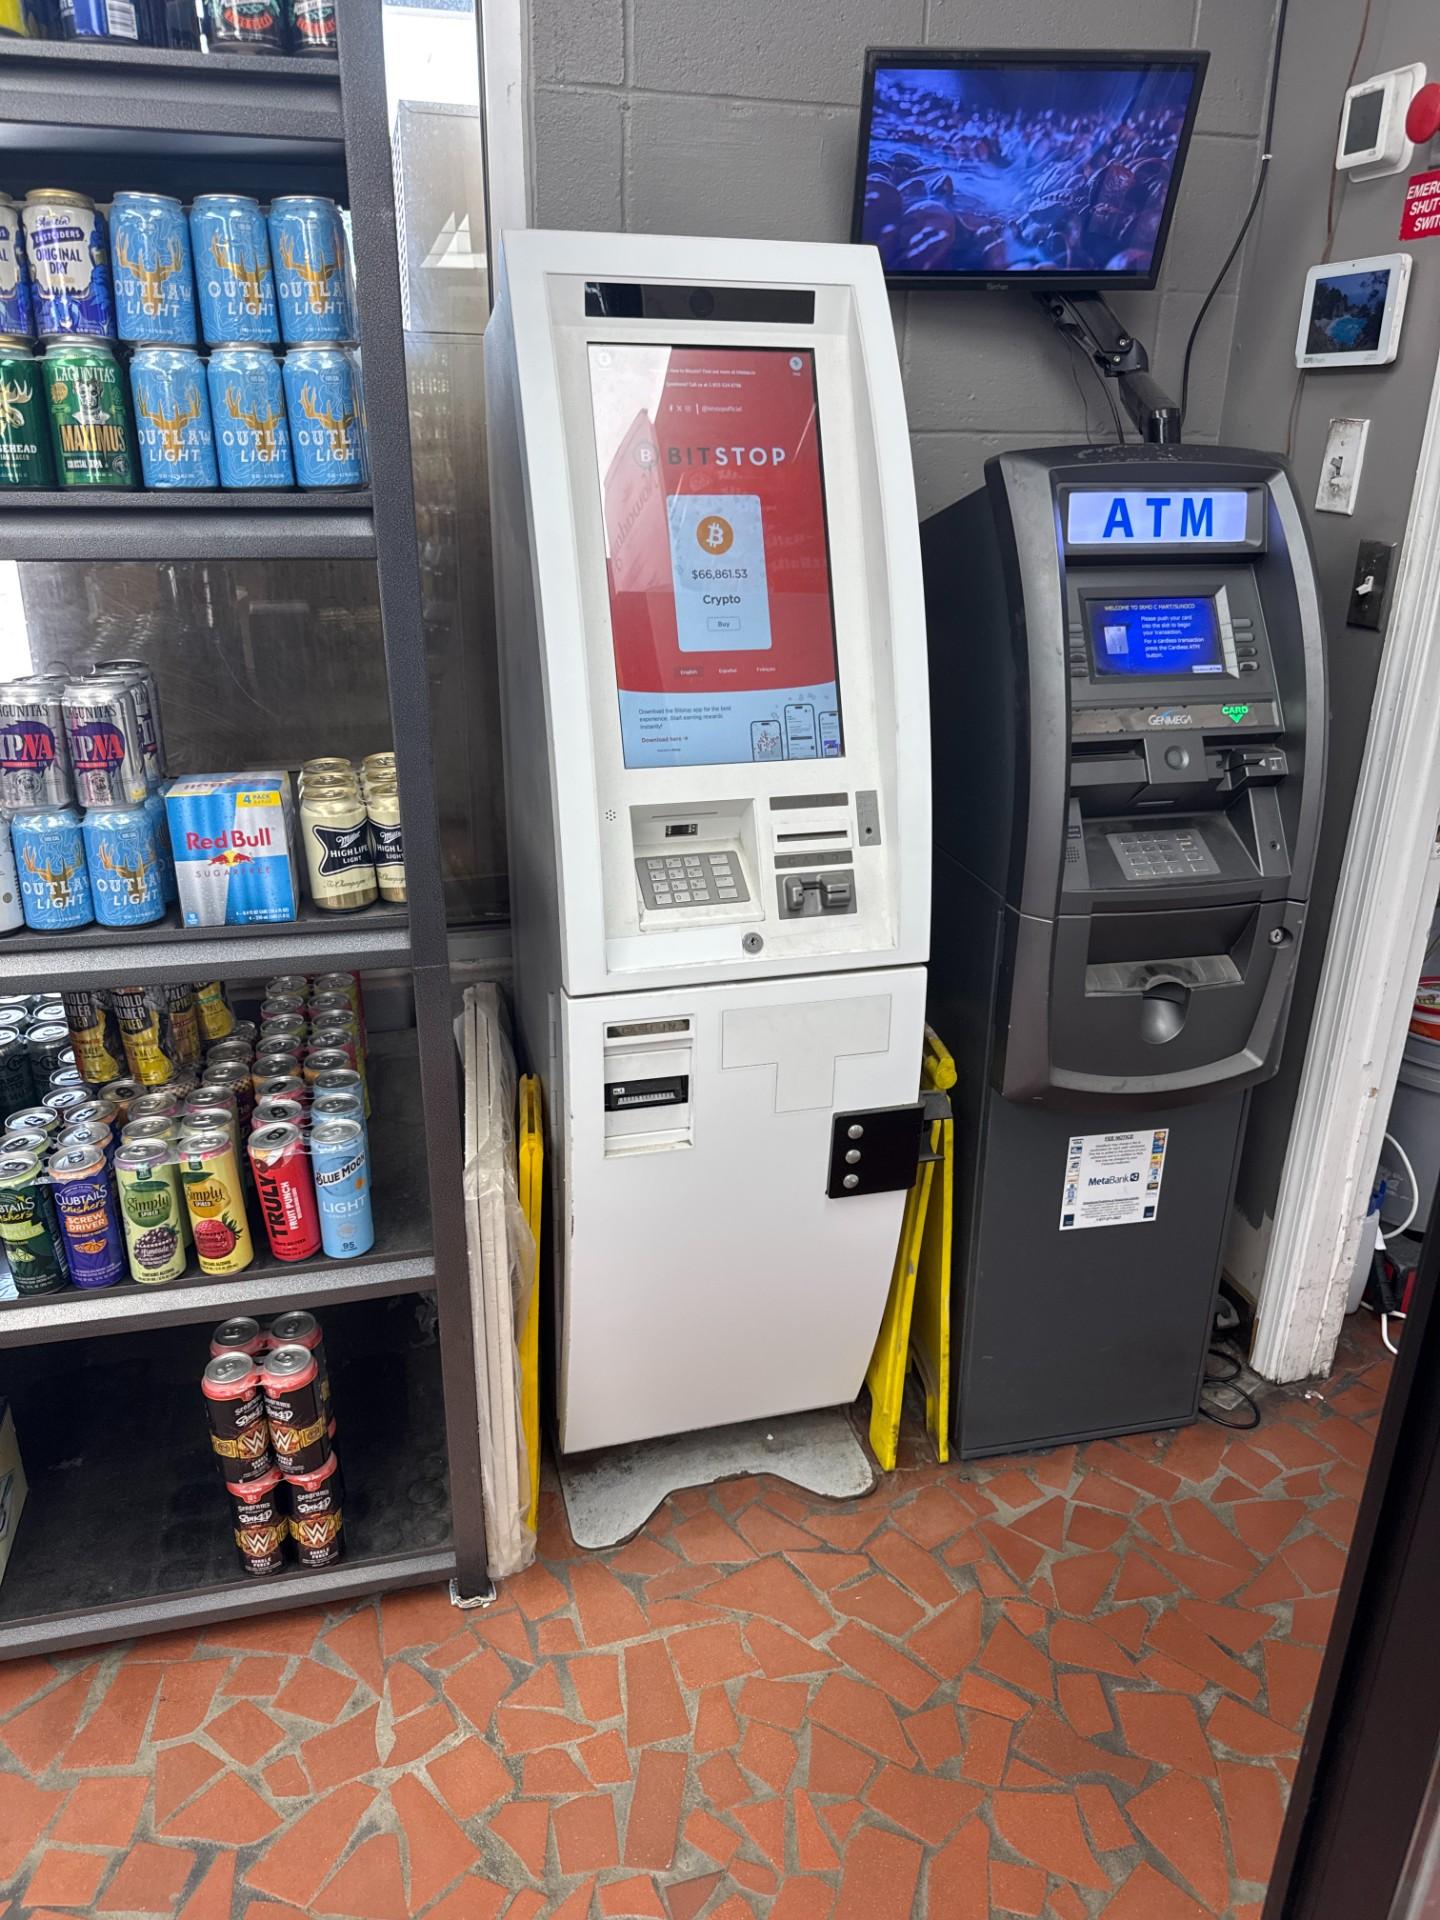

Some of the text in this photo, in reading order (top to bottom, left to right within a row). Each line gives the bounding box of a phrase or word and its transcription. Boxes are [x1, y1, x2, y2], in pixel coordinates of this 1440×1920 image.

[49, 262, 68, 274] DRY
[115, 280, 191, 298] OUTLAW
[208, 281, 274, 299] OUTLA
[279, 281, 344, 298] OUTLA
[127, 301, 180, 317] LIGHT
[228, 302, 274, 316] LIGHT
[295, 301, 343, 315] LIGHT
[61, 425, 126, 452] MAXIMUS
[138, 429, 211, 447] OUTLAW
[222, 430, 288, 447] OUTLA
[150, 448, 200, 463] LIGHT
[240, 449, 287, 463] LIGHT
[667, 447, 786, 466] BITSTOP
[1102, 497, 1213, 538] ATM
[691, 569, 748, 580] $66,861.53
[703, 594, 741, 606] Crypto
[717, 621, 730, 629] Buy
[1222, 705, 1248, 714] CARD
[186, 828, 272, 850] Red Bull
[330, 849, 353, 858] HIGH
[37, 893, 84, 909] LIGHT
[113, 889, 159, 906] LIGHT
[316, 1152, 365, 1185] BLUE MOON
[1088, 1174, 1130, 1187] MetaBank
[55, 1184, 108, 1206] CLUBTAILS
[127, 1194, 169, 1213] Simply
[280, 1181, 293, 1209] PUNCH
[258, 1173, 289, 1239] TRULY
[322, 1195, 366, 1213] LIGHT
[68, 1213, 102, 1225] SCREW
[69, 1218, 105, 1231] DRIVER
[286, 1208, 299, 1231] FRUIT
